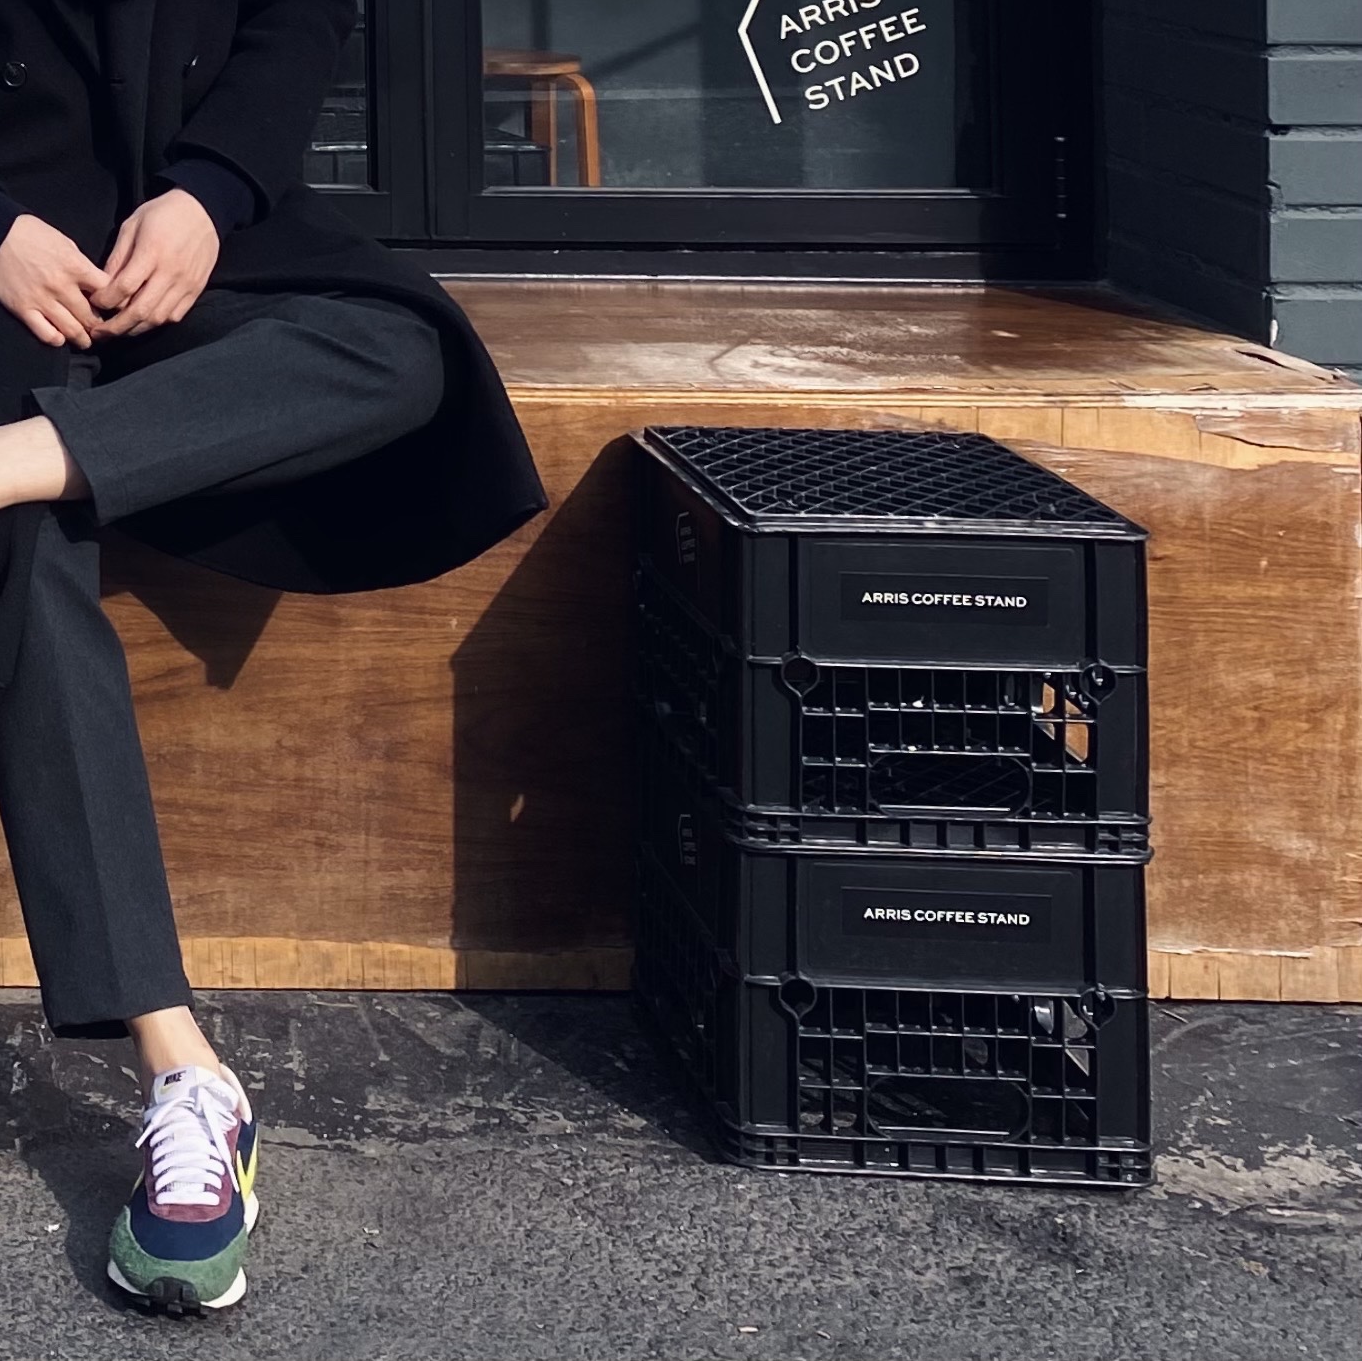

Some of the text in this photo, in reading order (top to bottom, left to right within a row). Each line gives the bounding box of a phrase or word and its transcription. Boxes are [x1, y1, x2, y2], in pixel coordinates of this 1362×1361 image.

[791, 8, 926, 72] COFFEE
[805, 54, 919, 109] STAND
[862, 592, 1027, 608] ARRIS COFFEE STAND
[863, 908, 1030, 925] ARRIS COFFEE STAND
